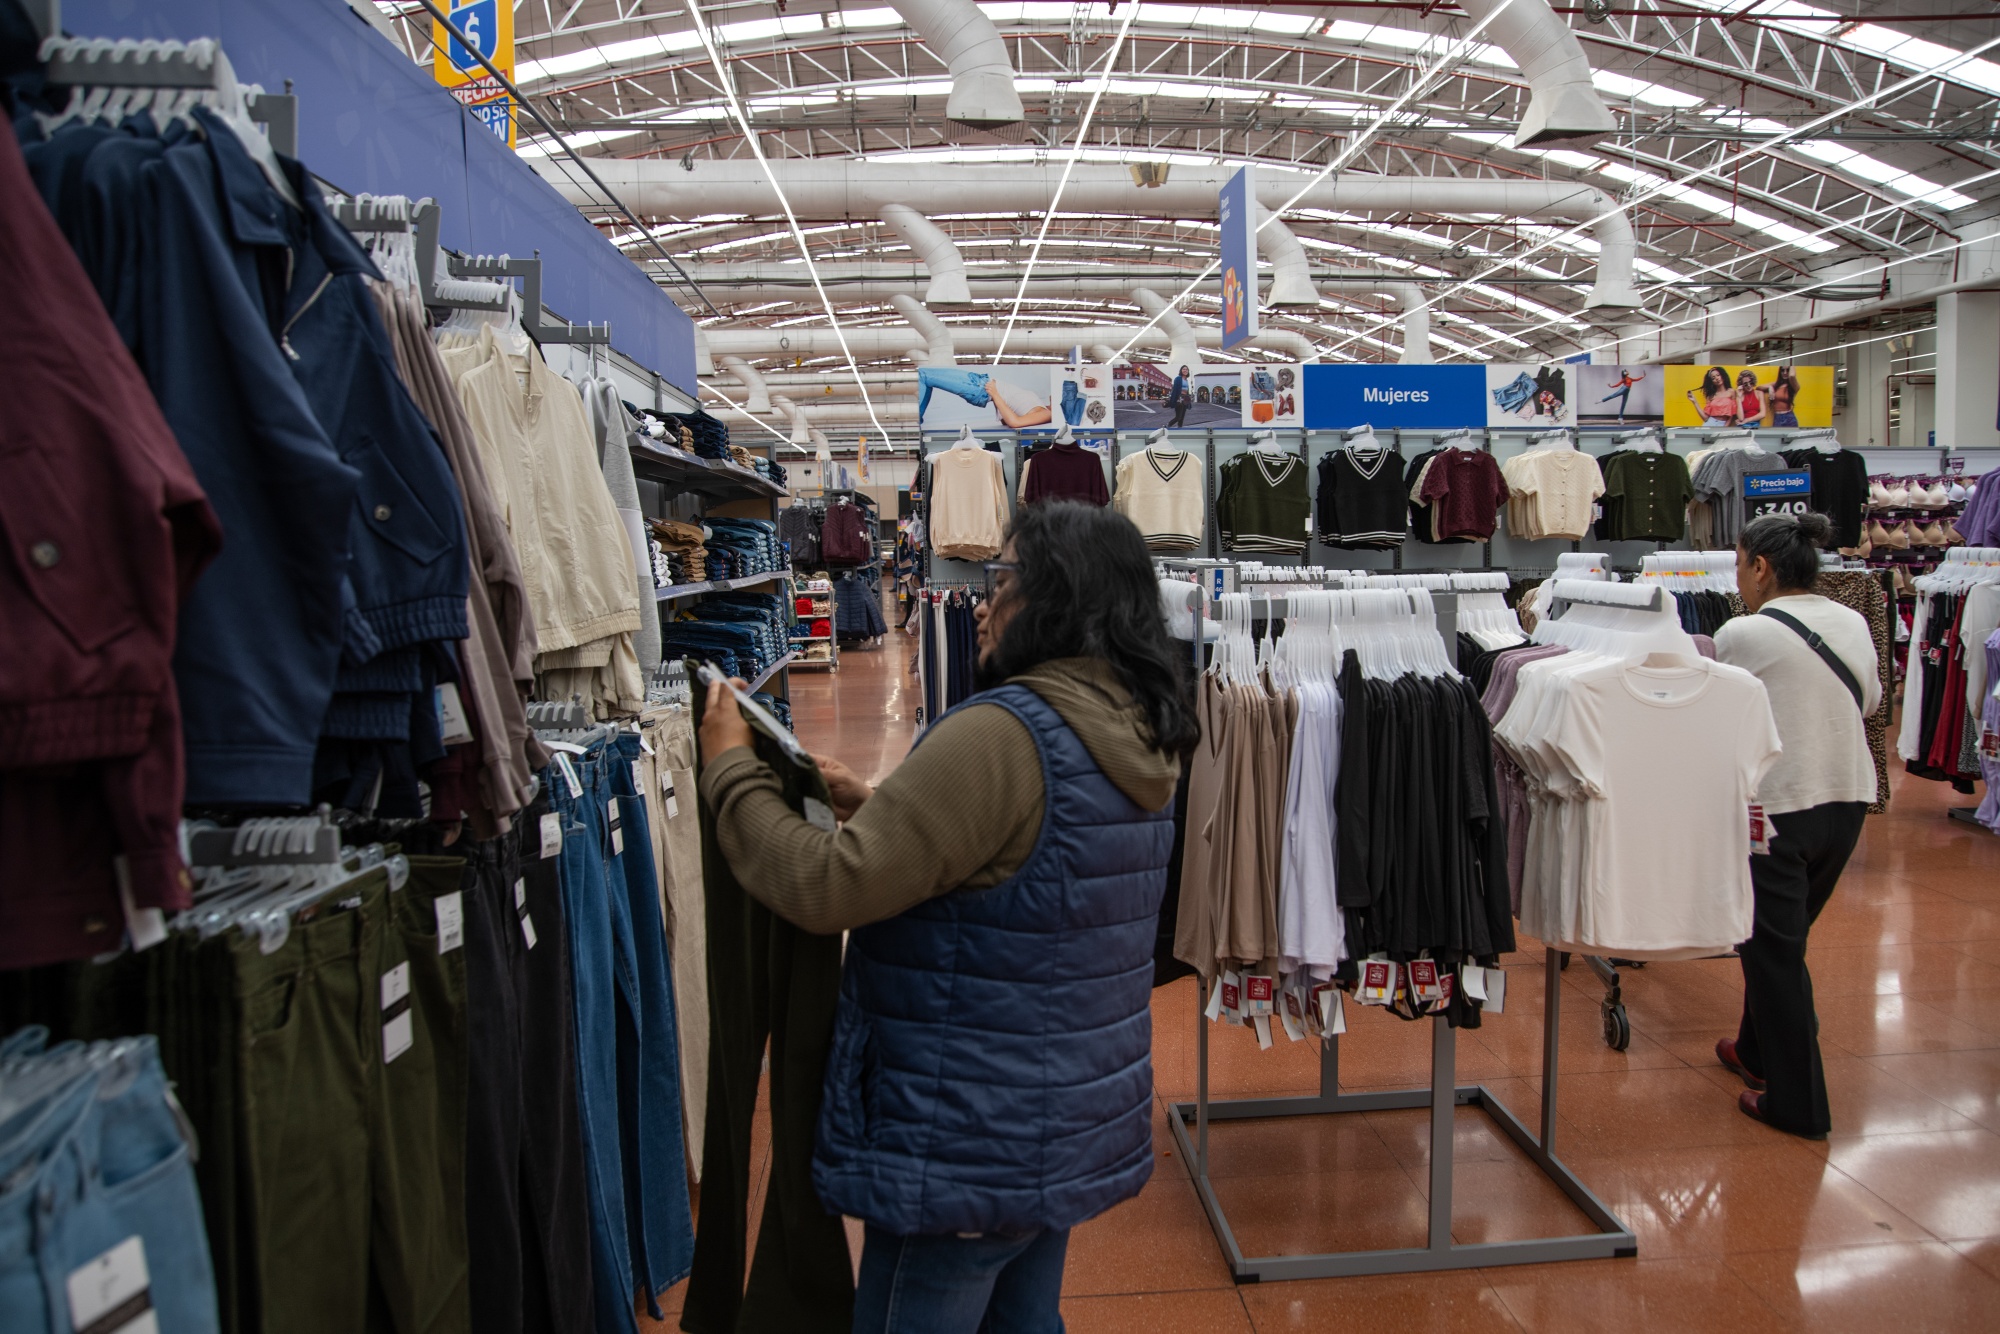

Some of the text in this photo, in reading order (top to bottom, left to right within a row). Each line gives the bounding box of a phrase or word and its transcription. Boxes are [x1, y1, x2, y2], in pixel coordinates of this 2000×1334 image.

[1363, 387, 1430, 405] Mujeres
[1760, 478, 1804, 487] Precio bajo
